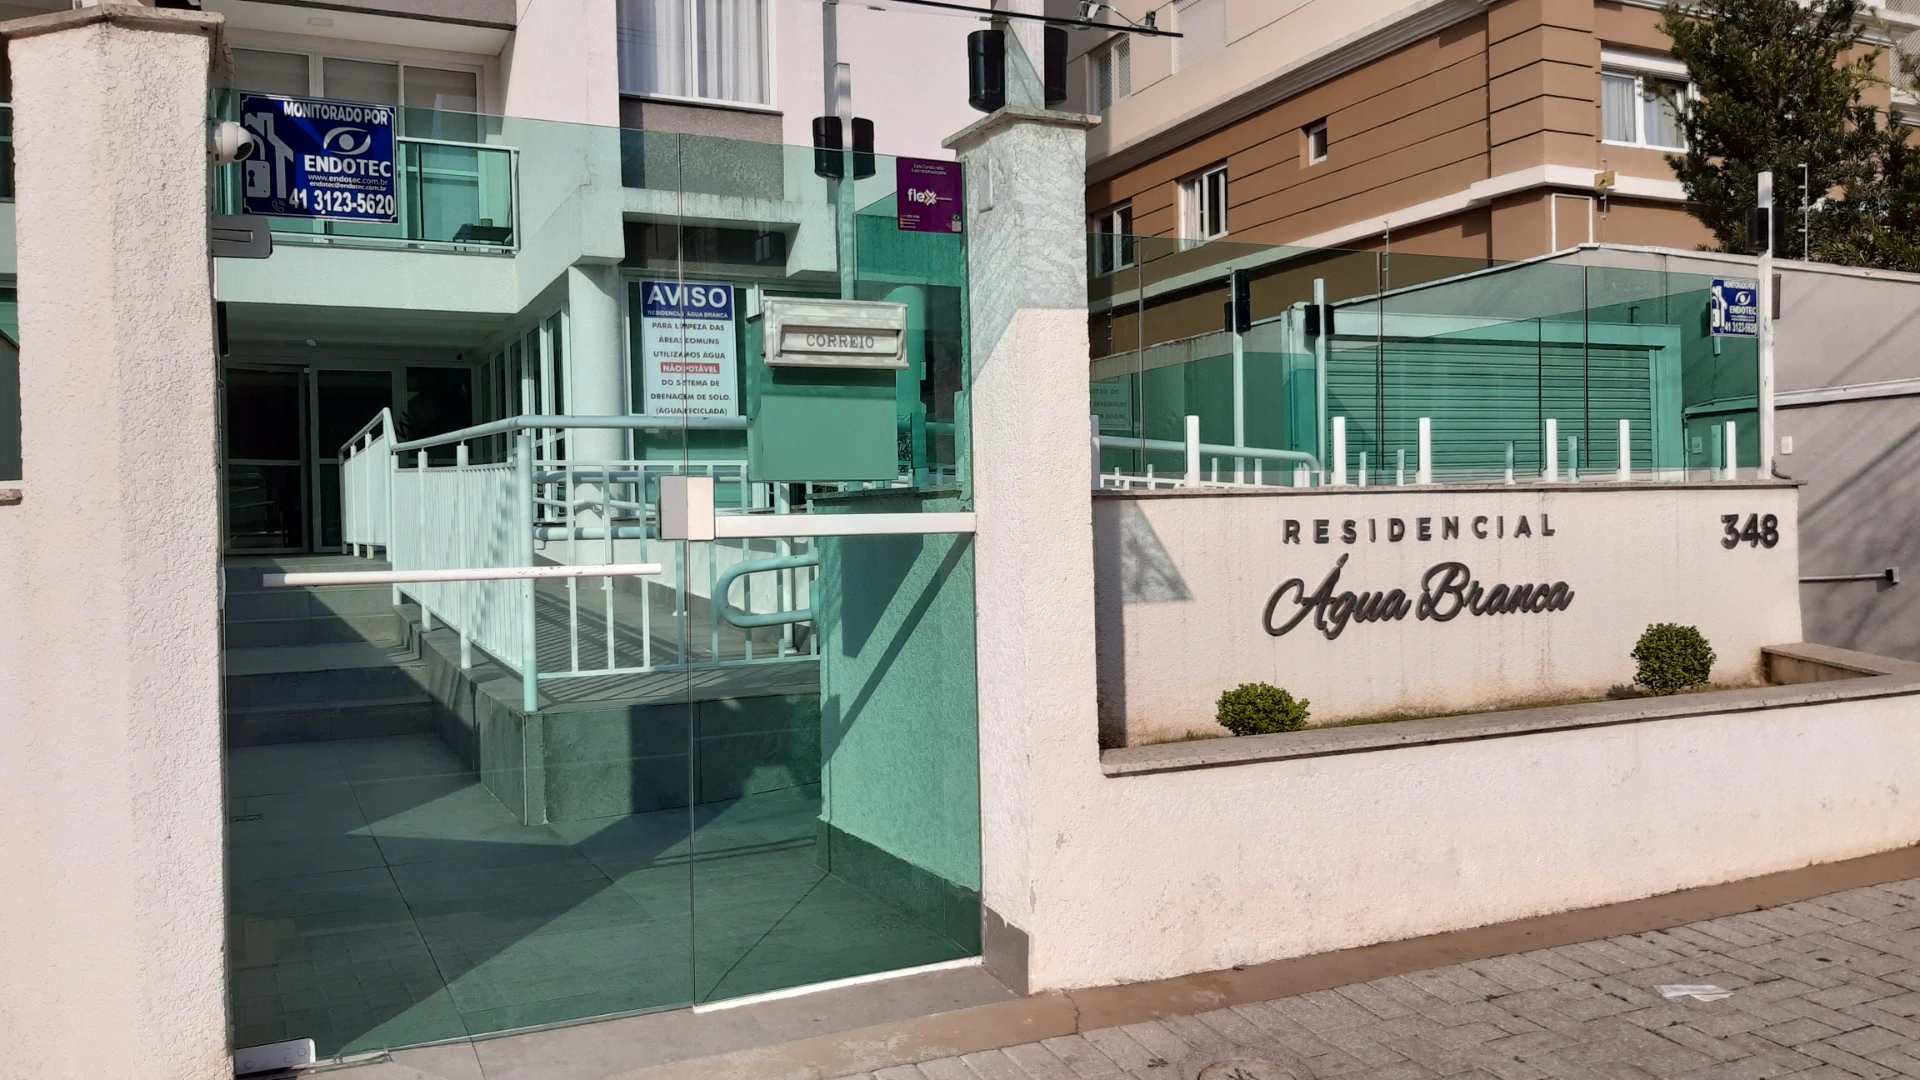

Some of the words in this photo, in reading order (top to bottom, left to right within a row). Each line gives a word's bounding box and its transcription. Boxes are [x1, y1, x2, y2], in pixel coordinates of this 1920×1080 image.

[283, 100, 362, 123] MONITORADO
[364, 109, 388, 125] POR
[304, 154, 392, 177] ENDOTEC
[308, 174, 388, 186] www.endotec.com.br
[309, 181, 387, 192] endotec@endotec.com.br
[289, 188, 308, 209] 41
[313, 189, 395, 215] 3123-5620
[907, 188, 937, 206] flex
[647, 285, 727, 308] AVISO
[703, 311, 729, 319] BRANCA
[675, 322, 707, 330] LPEZA
[709, 323, 725, 331] DAS
[806, 334, 875, 349] CORREIO
[702, 350, 726, 359] ÁGUA
[662, 363, 683, 372] NÃO
[676, 379, 708, 387] STEMA
[709, 393, 732, 401] SOLO.
[1282, 513, 1556, 545] RESIDENCIAL
[1720, 513, 1779, 550] 348
[1261, 552, 1413, 641] Água
[1415, 561, 1575, 623] Branca
